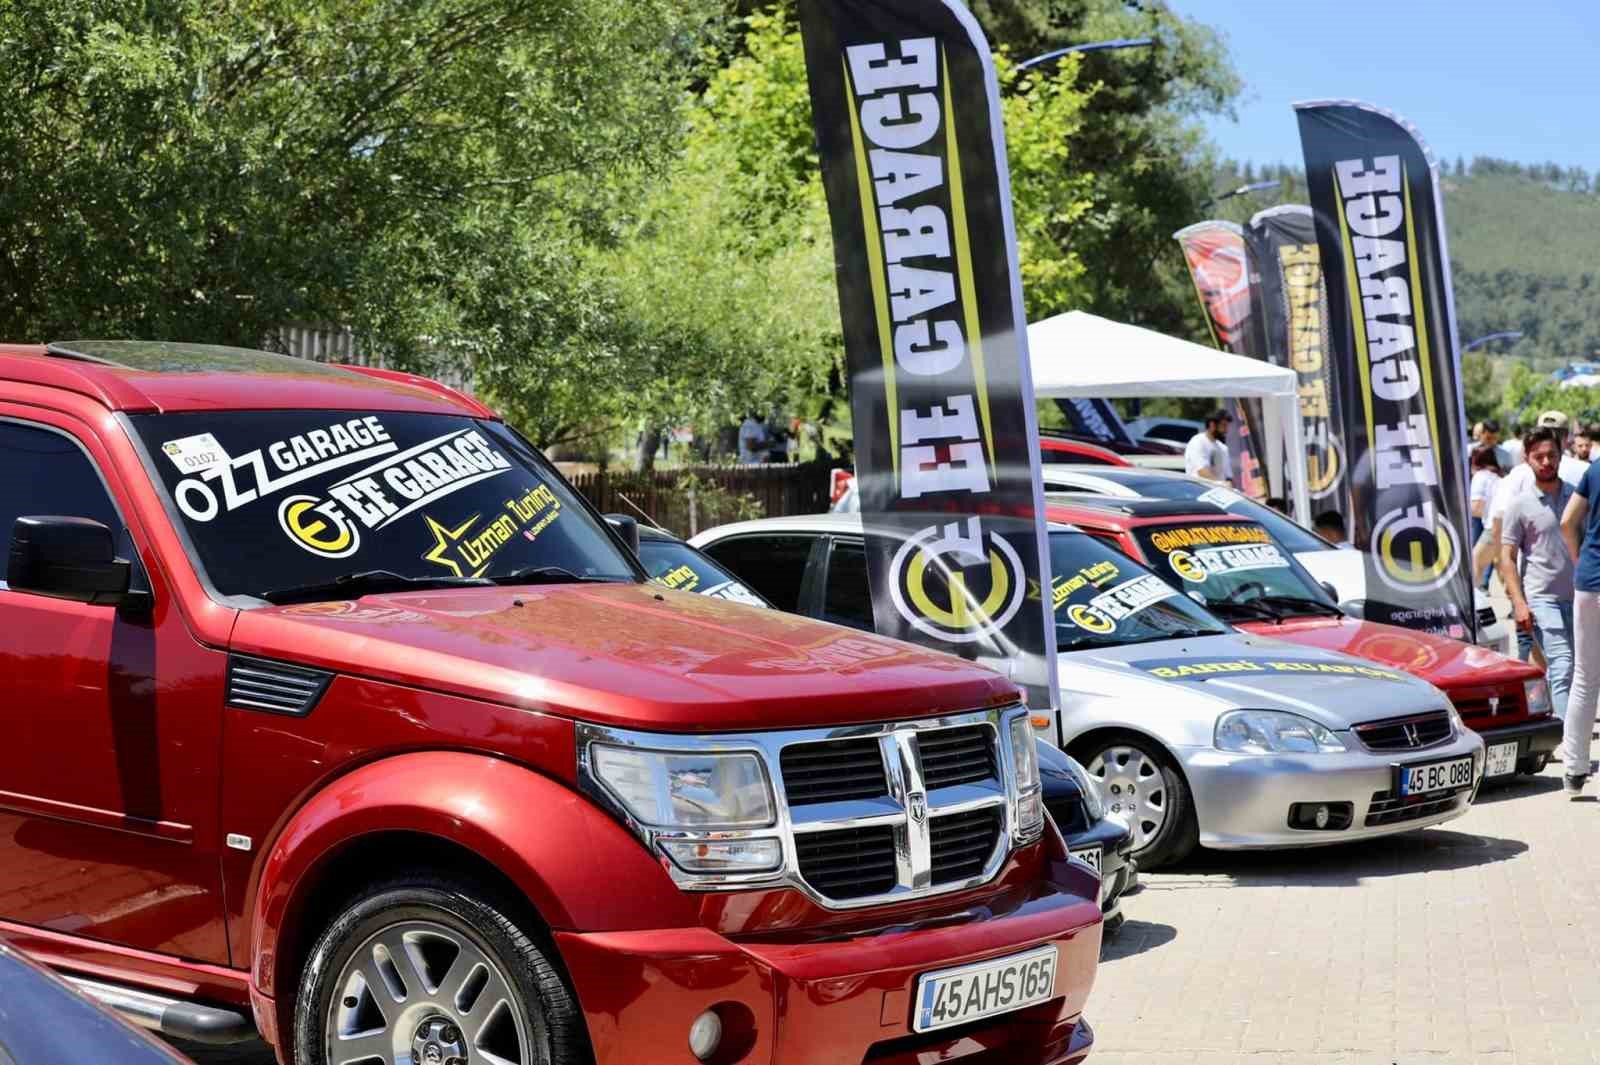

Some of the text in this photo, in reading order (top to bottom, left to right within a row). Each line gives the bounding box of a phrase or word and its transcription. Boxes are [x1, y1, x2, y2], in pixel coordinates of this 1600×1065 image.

[184, 452, 219, 467] 0102
[269, 415, 391, 472] GARAGE
[328, 430, 512, 529] EF GARAGE
[457, 514, 518, 568] Uzman
[506, 484, 561, 523] Tuning
[1408, 761, 1470, 792] 45 BC 088
